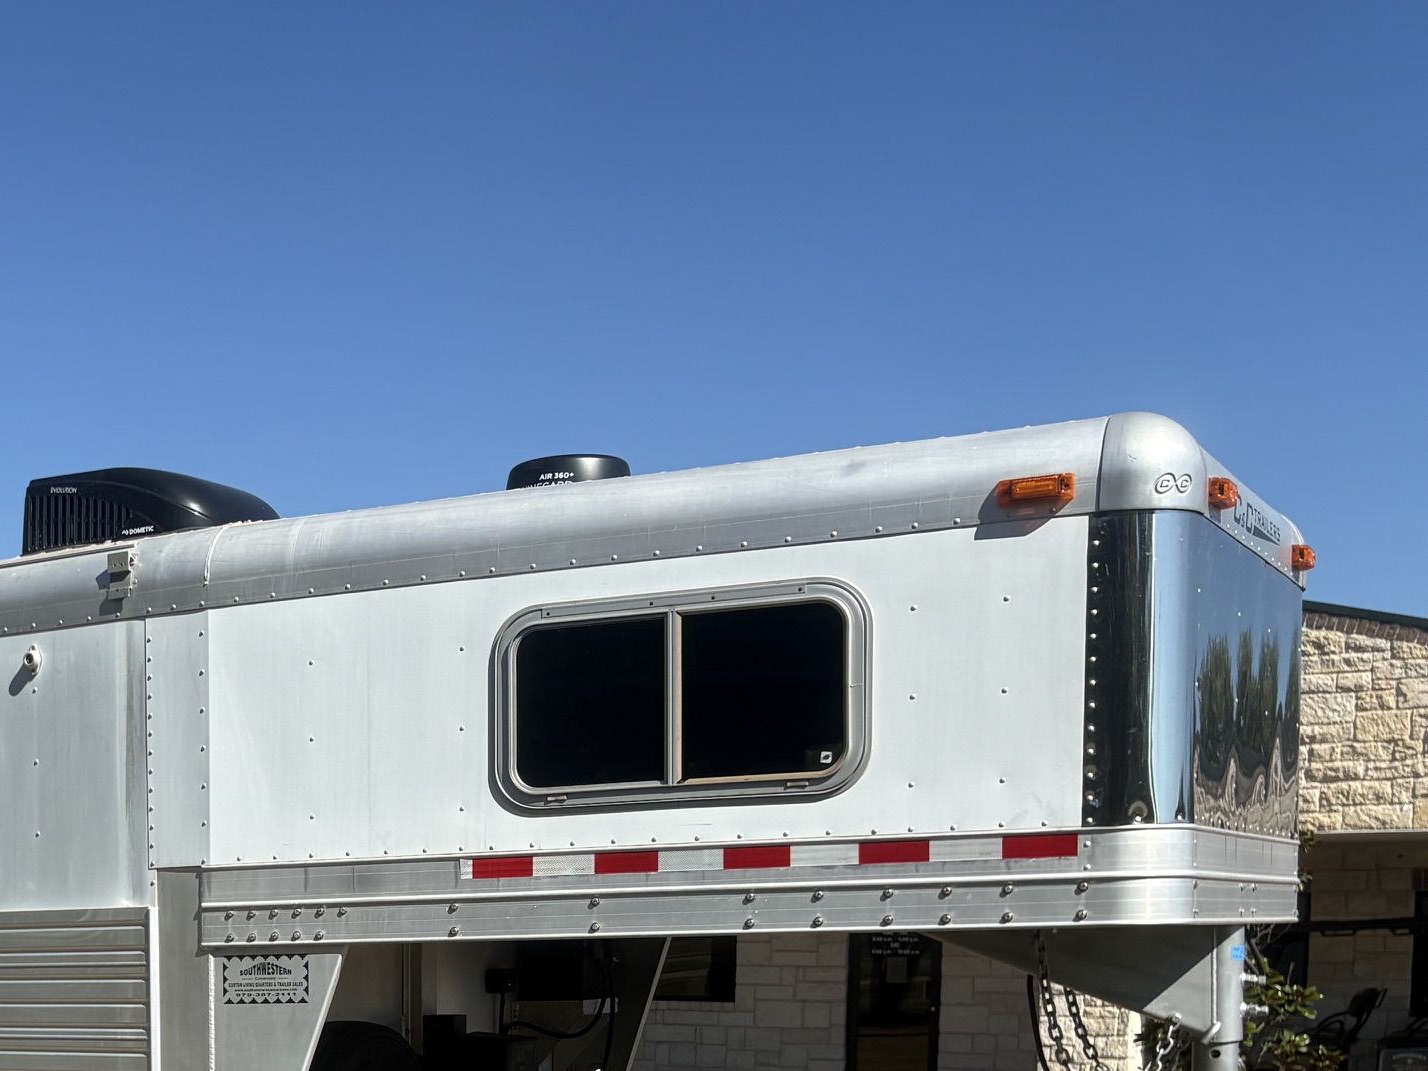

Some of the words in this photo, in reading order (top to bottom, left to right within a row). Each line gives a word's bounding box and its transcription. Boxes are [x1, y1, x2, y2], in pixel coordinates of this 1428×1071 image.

[538, 473, 553, 481] AIR
[553, 471, 575, 480] 360+
[50, 486, 78, 494] EVOLUTION
[128, 525, 155, 536] DOMETIC
[1253, 507, 1281, 543] TRAILERS
[239, 961, 292, 976] SOUTHWESTERN
